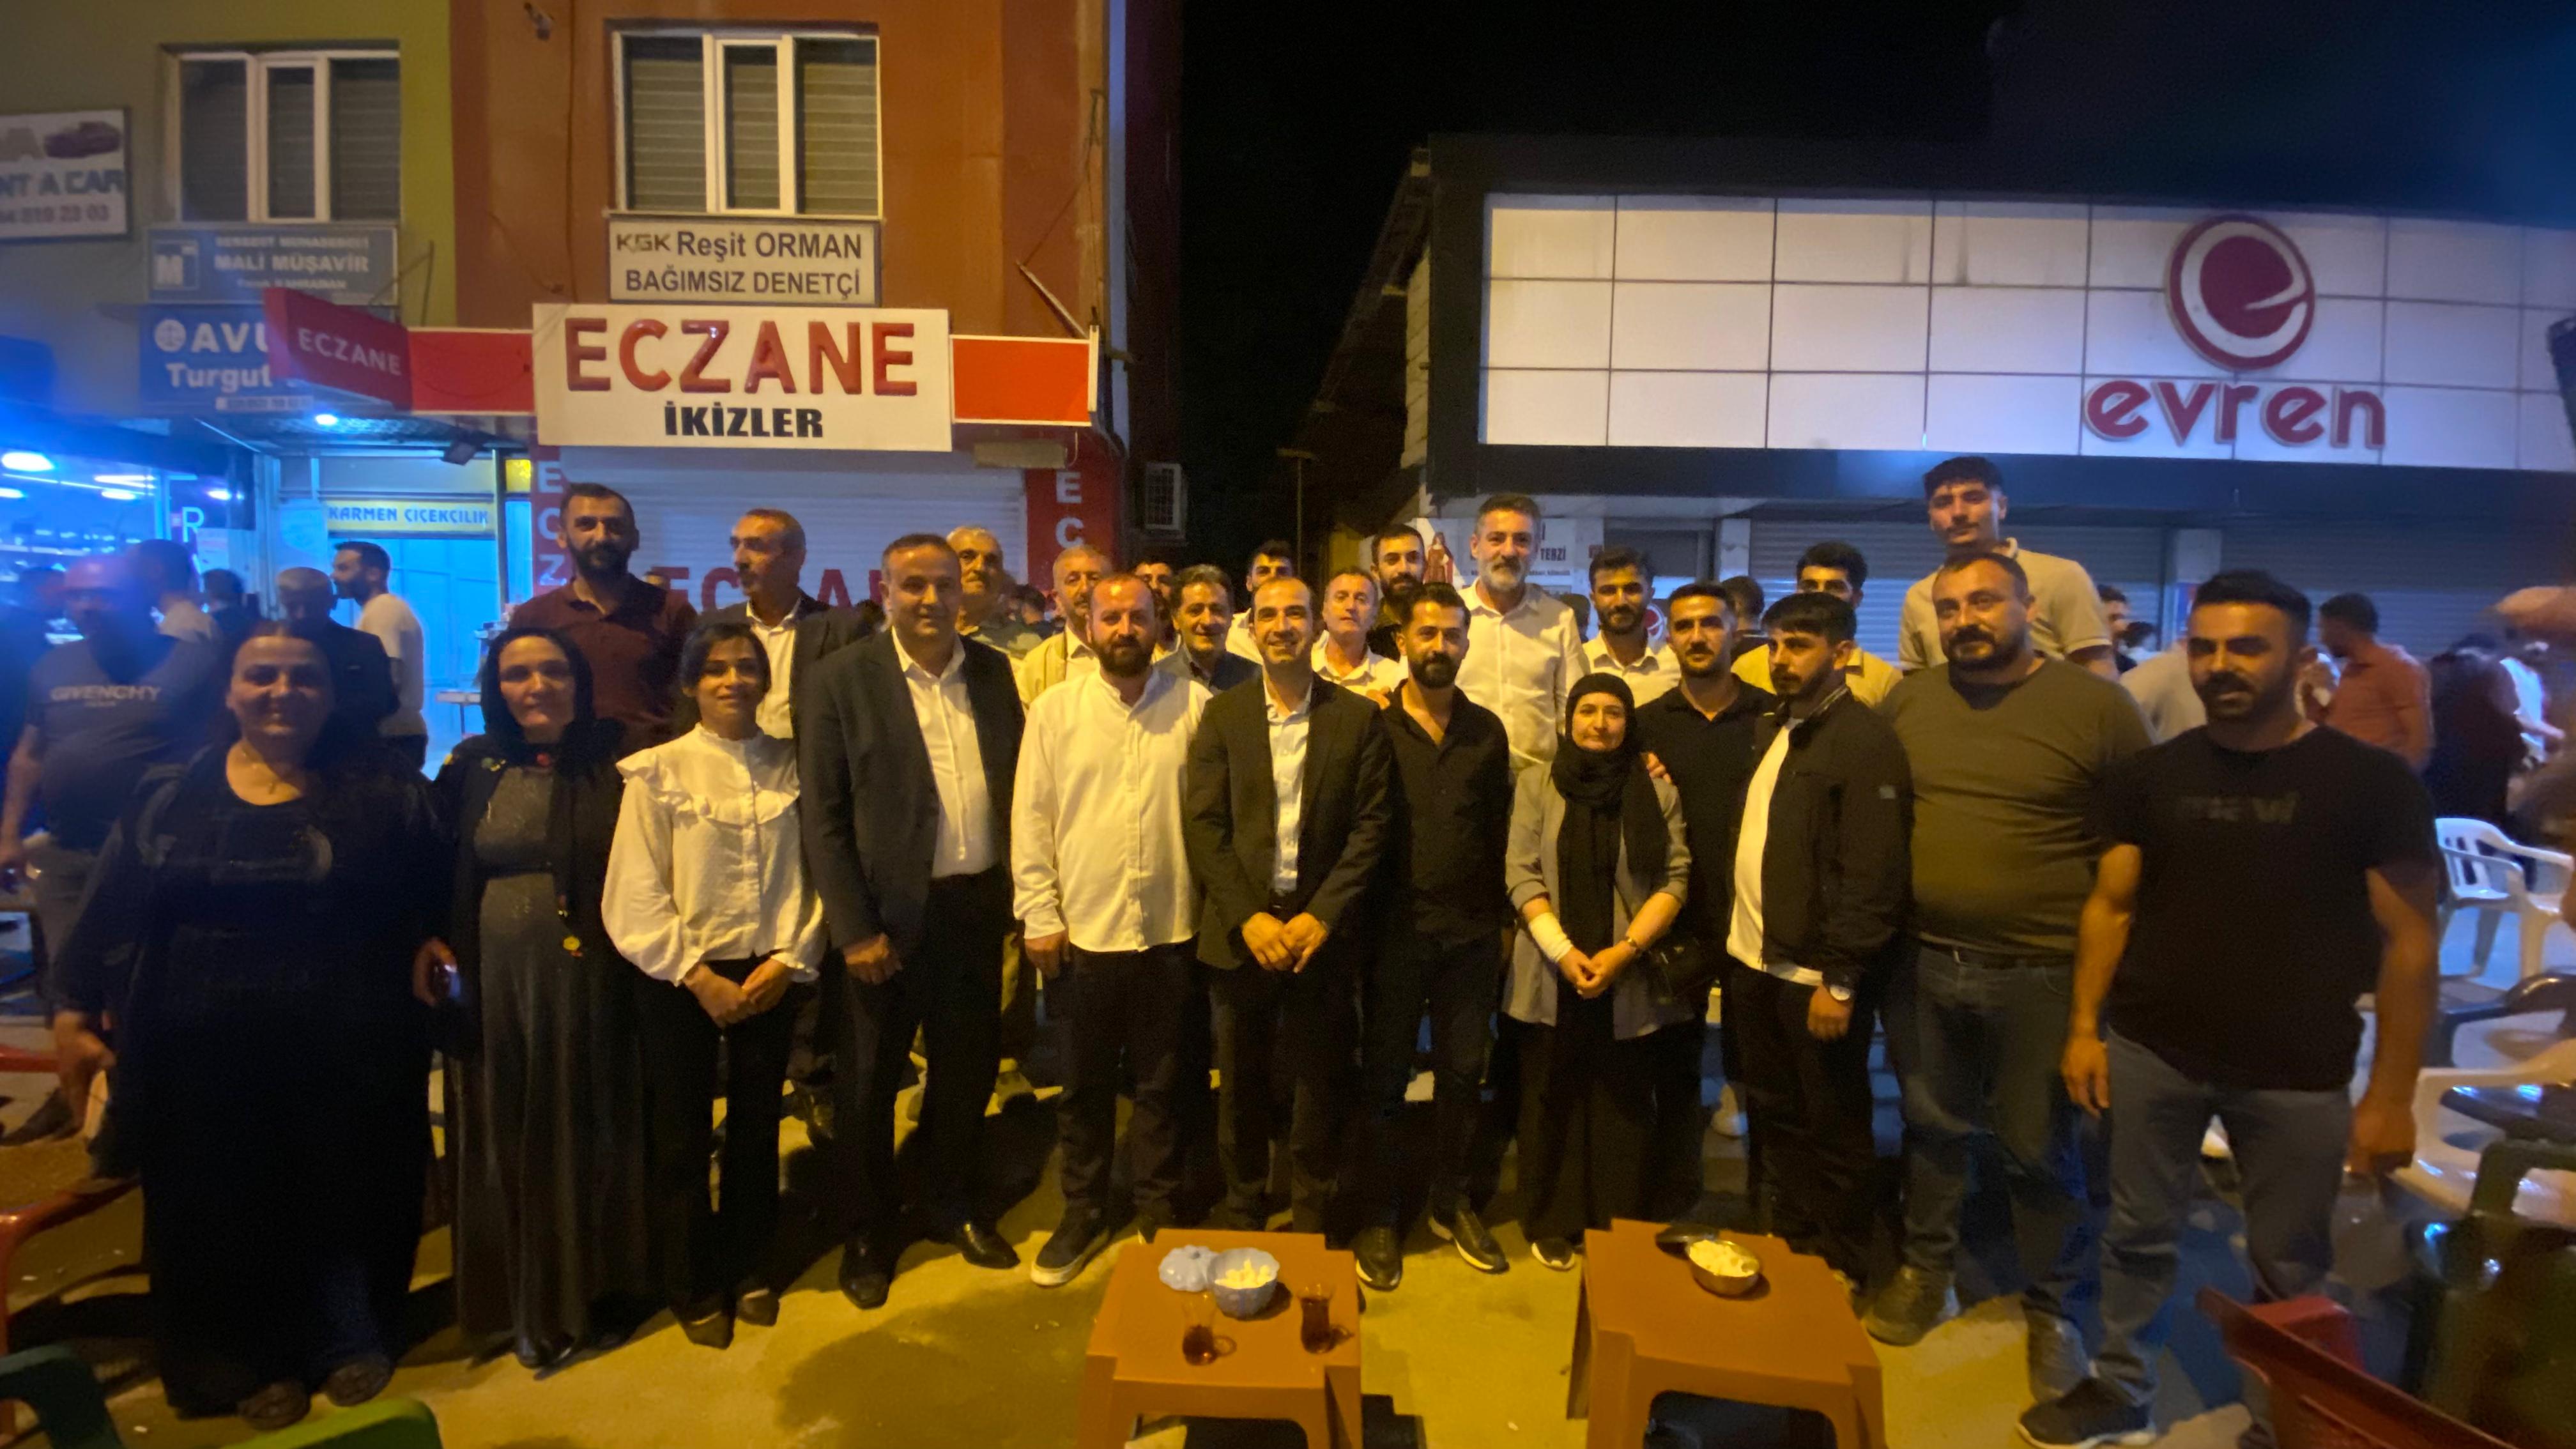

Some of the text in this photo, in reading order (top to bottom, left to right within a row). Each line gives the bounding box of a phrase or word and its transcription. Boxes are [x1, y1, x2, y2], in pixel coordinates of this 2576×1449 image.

[38, 170, 61, 197] A
[677, 231, 746, 263] Reşit
[755, 232, 862, 259] ORMAN
[215, 252, 369, 275] MALİ MÜŞAVİR
[625, 264, 861, 300] BAĞIMSIZ DENETÇİ
[297, 326, 402, 376] ECZANE
[564, 316, 918, 397] ECZANE
[166, 362, 273, 393] Turgut
[664, 400, 824, 439] İKİZLER
[2085, 378, 2386, 450] evren
[328, 506, 398, 522] KARMEN
[1540, 544, 1566, 562] TERZİ
